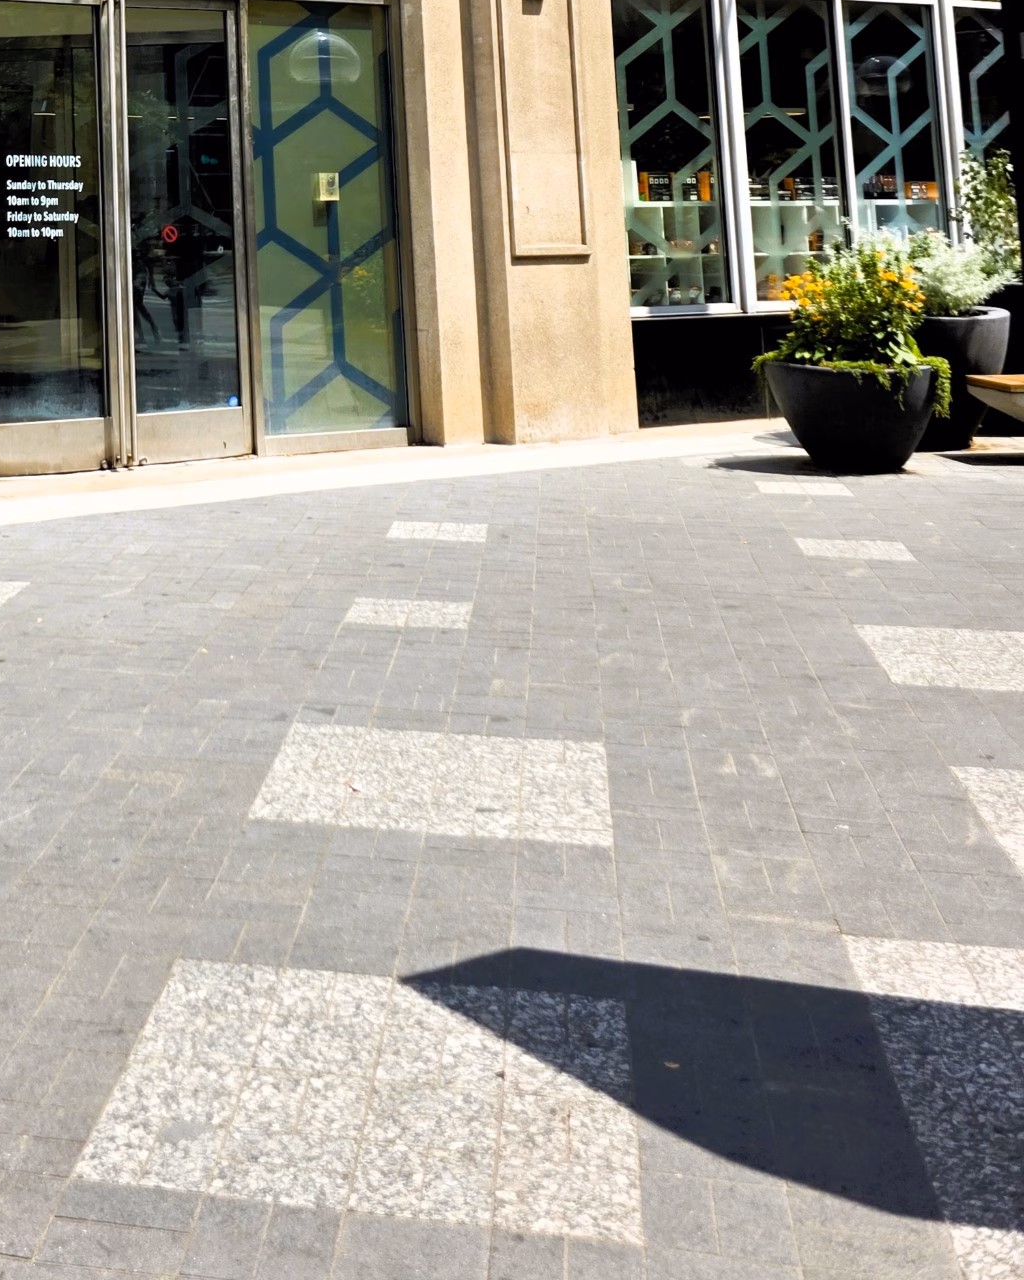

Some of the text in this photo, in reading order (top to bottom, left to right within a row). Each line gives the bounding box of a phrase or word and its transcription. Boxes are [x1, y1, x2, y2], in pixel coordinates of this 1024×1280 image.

[6, 154, 82, 168] OPENING HOURS
[6, 179, 84, 192] Sunday to Thursday
[6, 195, 59, 208] 10am to 9pm
[7, 211, 79, 224] Friday to Saturday
[7, 227, 63, 239] 10am to 10pm
